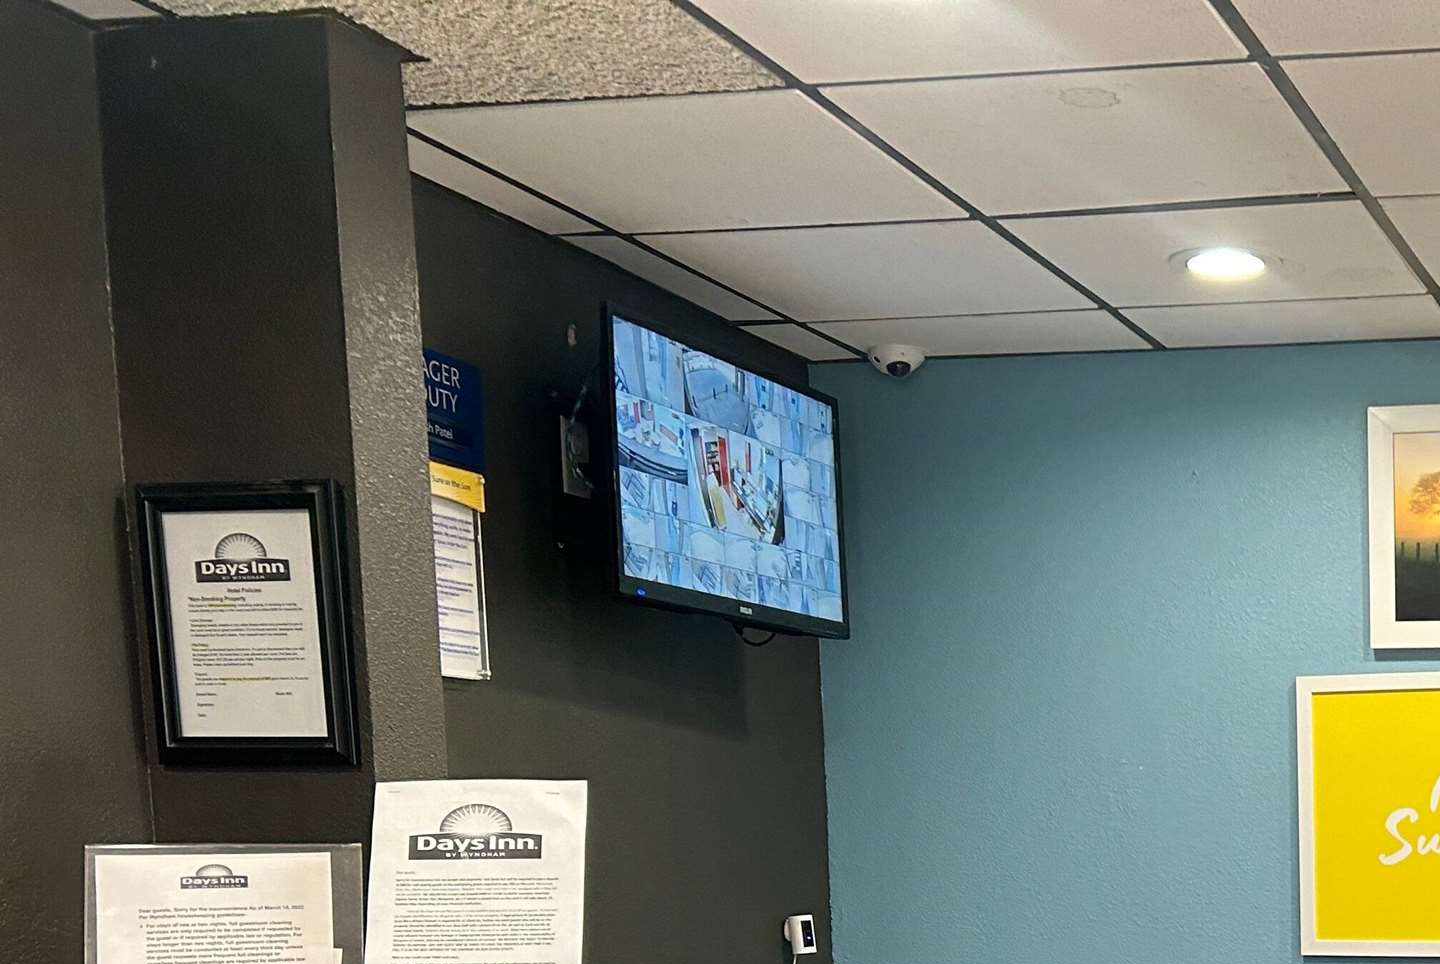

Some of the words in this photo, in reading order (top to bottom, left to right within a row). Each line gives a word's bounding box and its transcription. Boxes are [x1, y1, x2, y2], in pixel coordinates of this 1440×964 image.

[422, 356, 460, 389] AGER
[428, 385, 458, 413] UTY
[200, 561, 249, 575] Days
[417, 836, 485, 853] Days
[182, 877, 218, 887] Days
[220, 876, 246, 885] Inn
